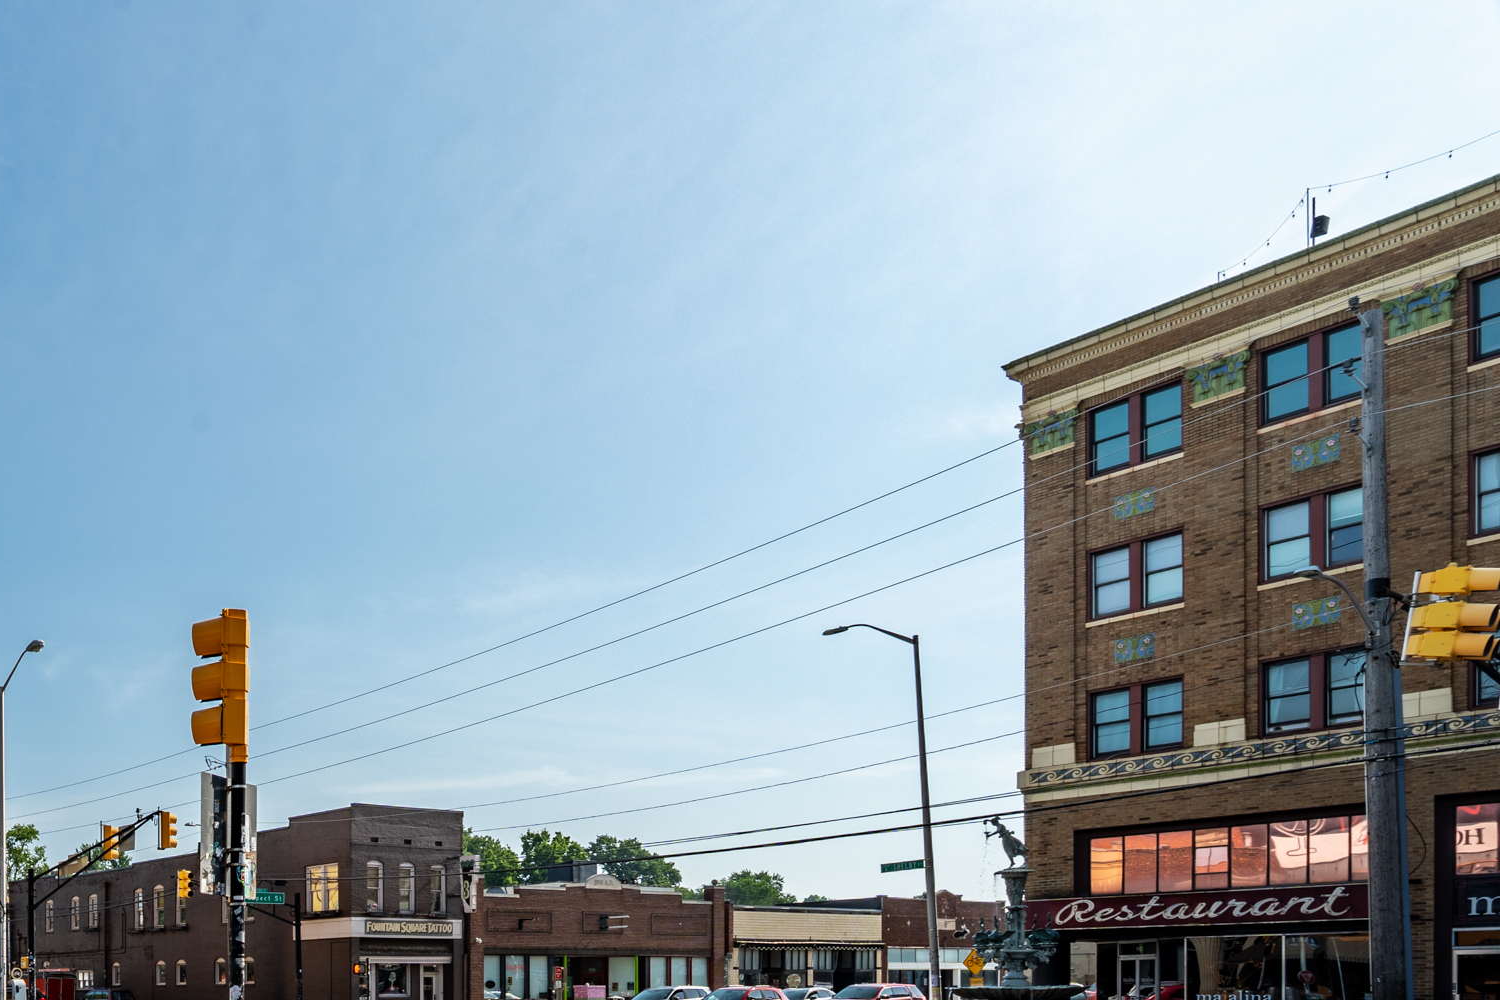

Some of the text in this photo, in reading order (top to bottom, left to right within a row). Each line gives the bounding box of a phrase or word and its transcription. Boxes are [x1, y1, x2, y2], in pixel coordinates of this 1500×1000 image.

[892, 861, 917, 870] SHELBY
[1054, 887, 1351, 925] Restaurant
[366, 921, 453, 934] FOUNTAIN SQUARE TATTOO
